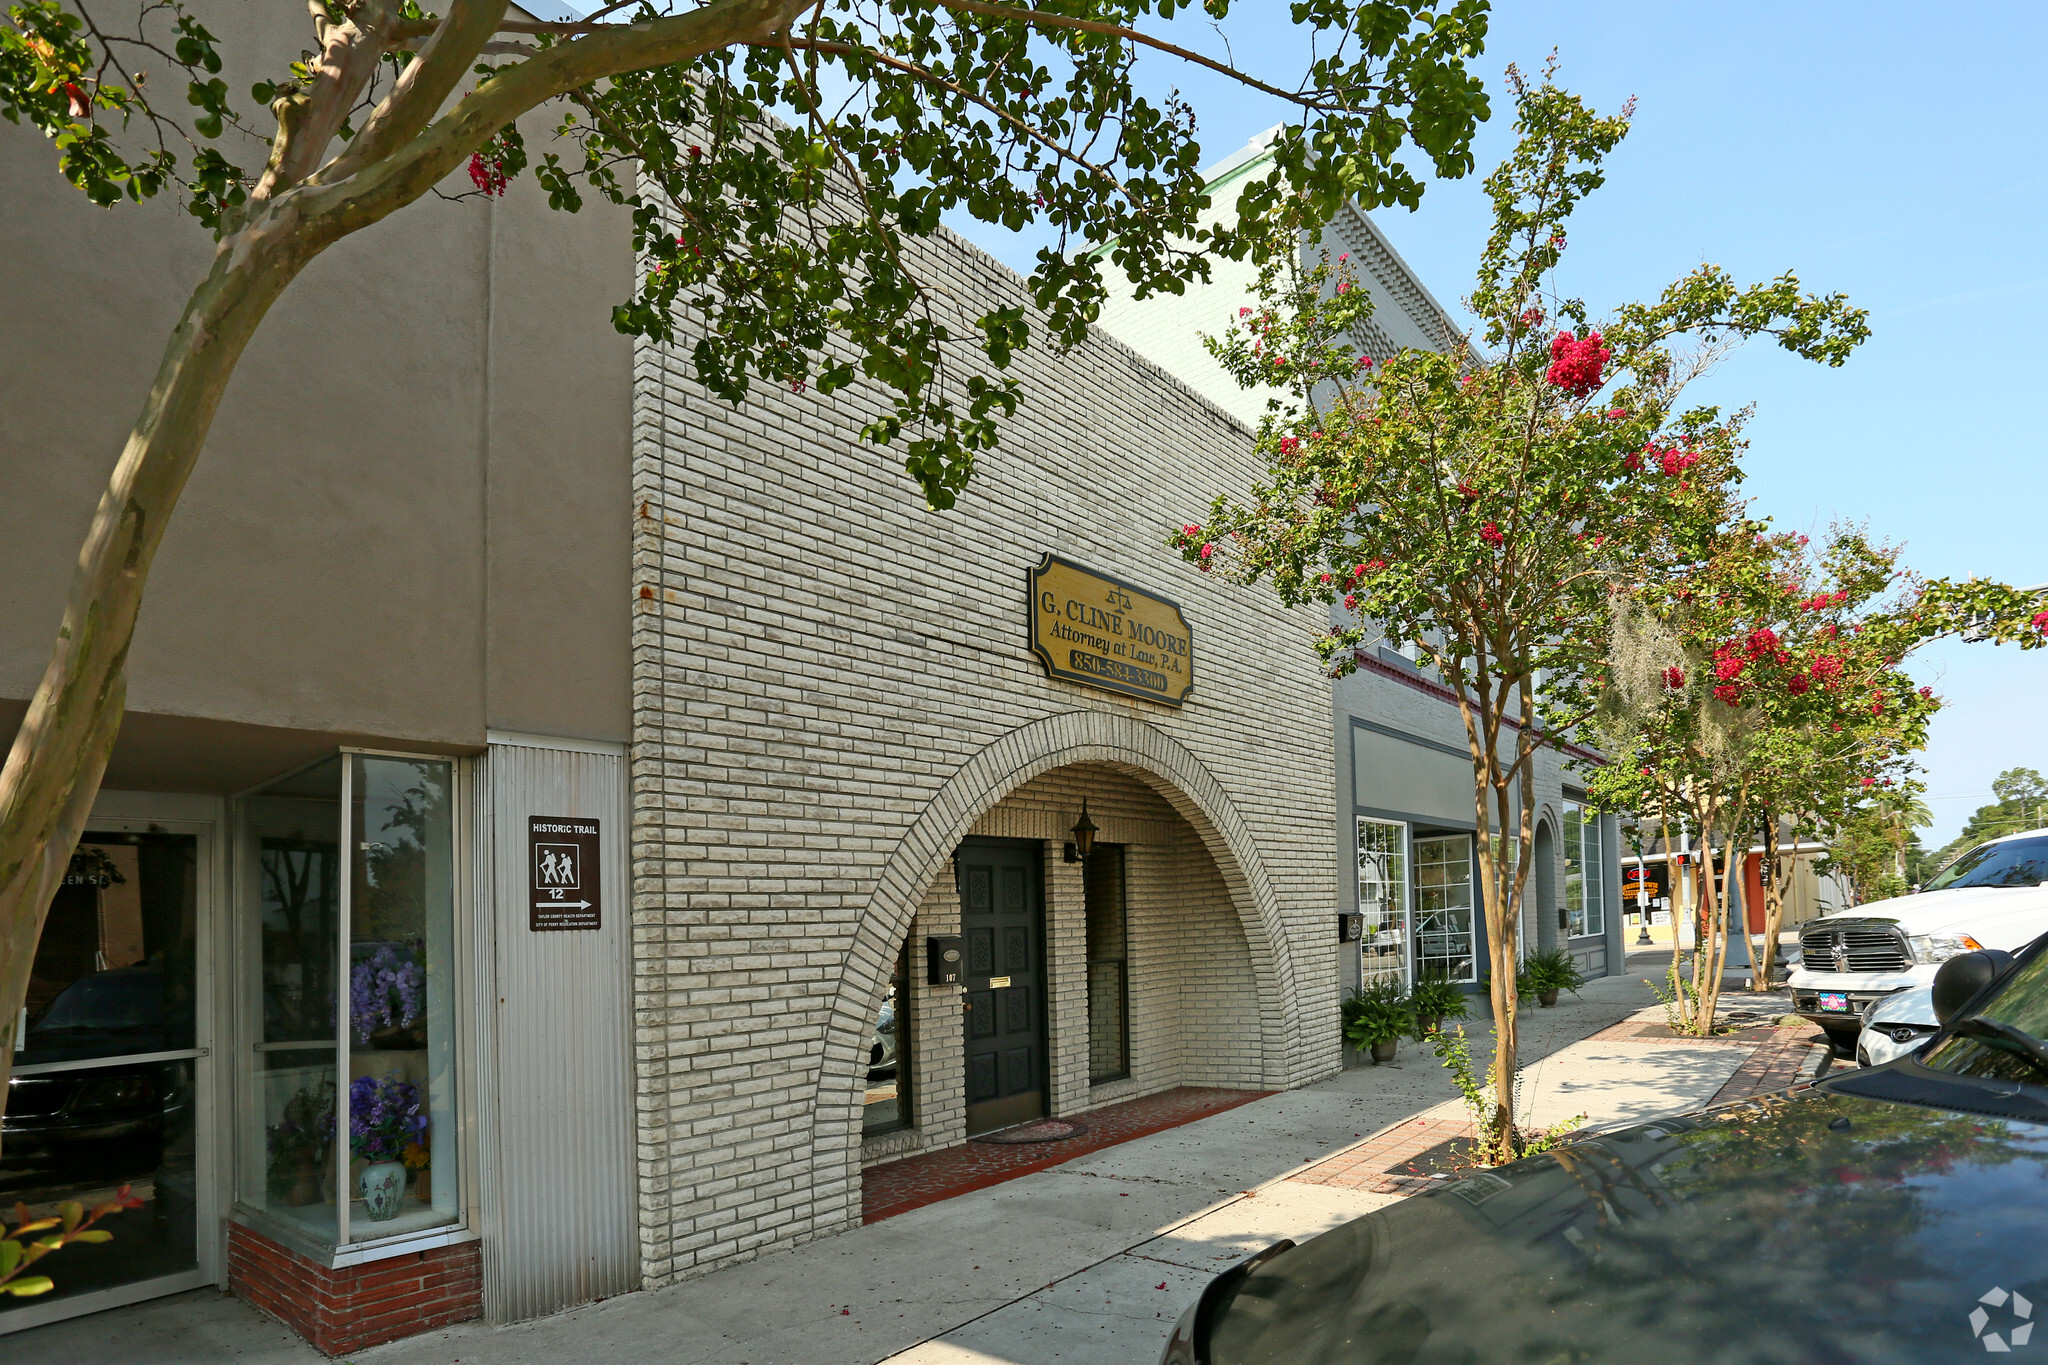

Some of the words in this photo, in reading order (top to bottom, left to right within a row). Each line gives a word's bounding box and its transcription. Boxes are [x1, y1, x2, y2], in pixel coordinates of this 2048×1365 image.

[1041, 591, 1061, 616] G.
[1066, 599, 1123, 636] CLINE
[1128, 619, 1188, 657] MOORE
[1050, 620, 1110, 655] Attorney
[1113, 642, 1126, 656] at
[1130, 643, 1158, 669] Law,
[1160, 653, 1182, 673] P.A.
[1073, 651, 1165, 691] 850-584-3300
[533, 823, 572, 834] HISTORIC
[573, 825, 597, 834] TRAIL
[1627, 870, 1651, 879] OPN
[548, 889, 564, 899] 12
[946, 973, 956, 982] 107
